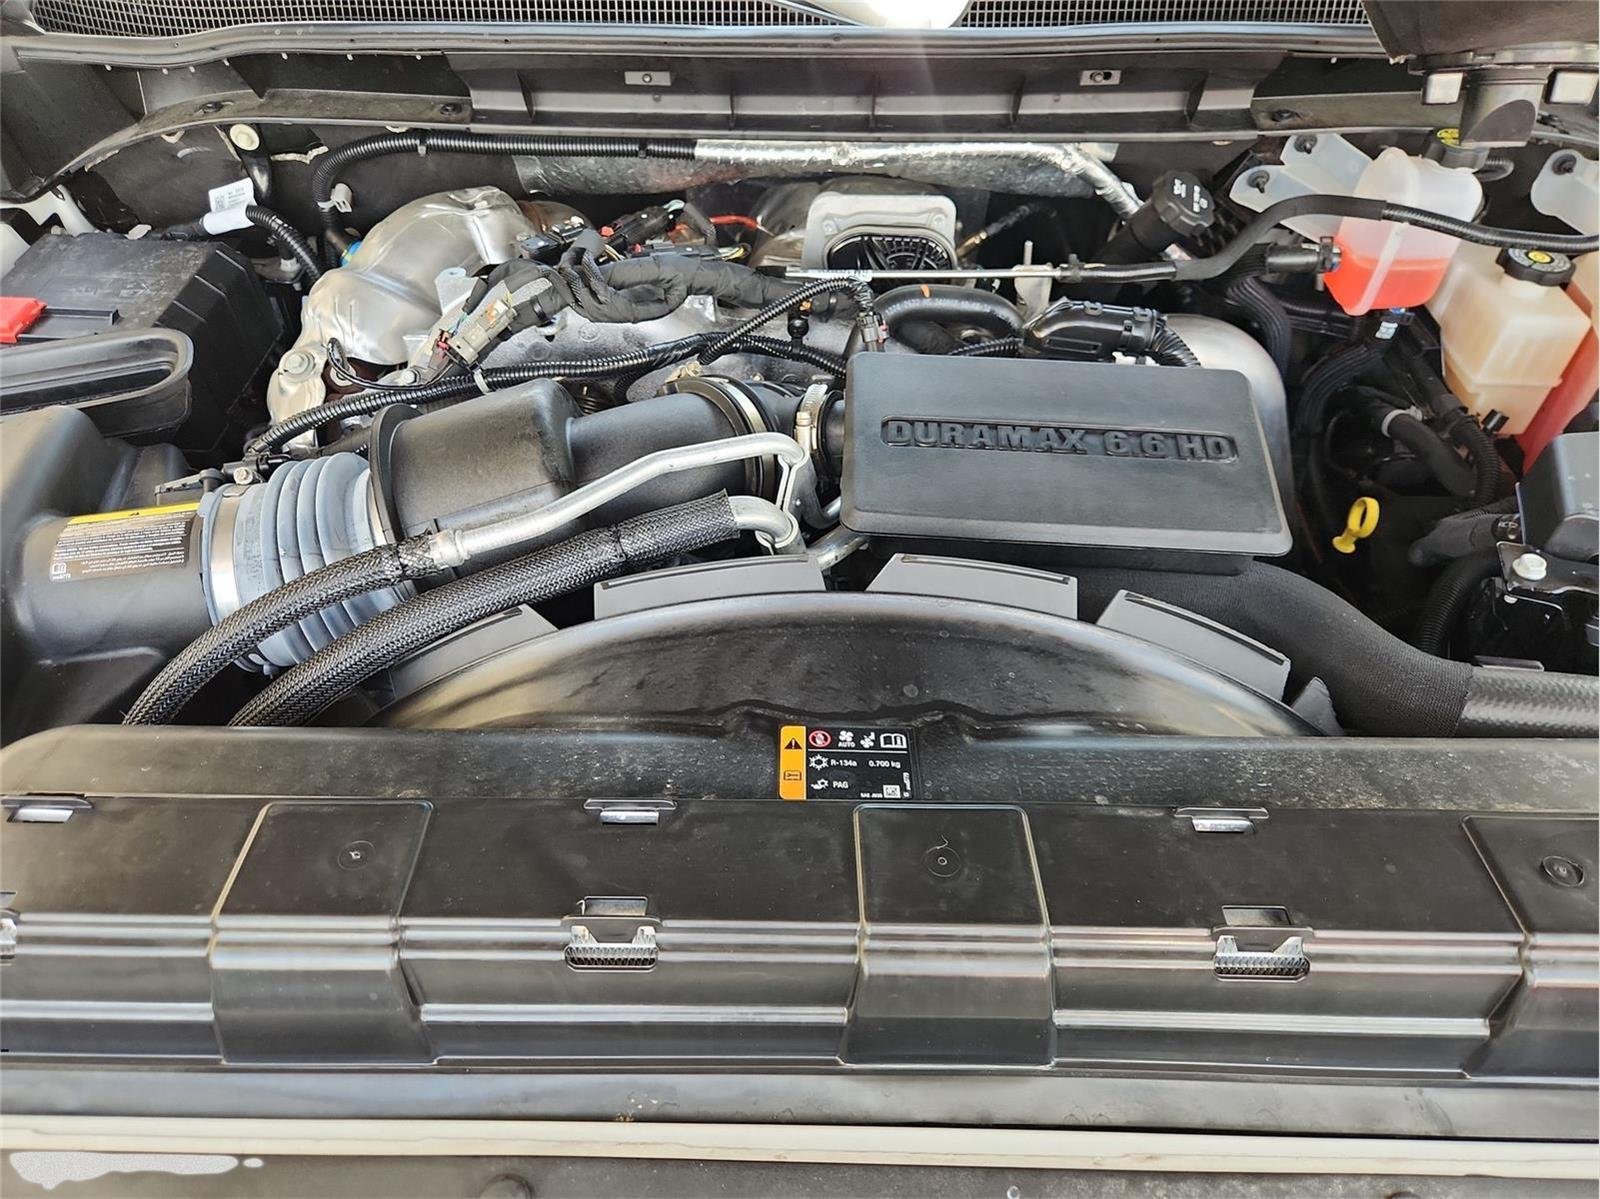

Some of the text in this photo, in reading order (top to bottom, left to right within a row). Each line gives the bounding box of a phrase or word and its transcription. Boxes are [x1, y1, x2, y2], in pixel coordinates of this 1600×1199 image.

[887, 420, 1088, 455] DURAMAX
[1176, 434, 1232, 462] HD
[830, 759, 857, 767] R-134a
[890, 760, 901, 769] kg
[832, 781, 849, 789] PAG
